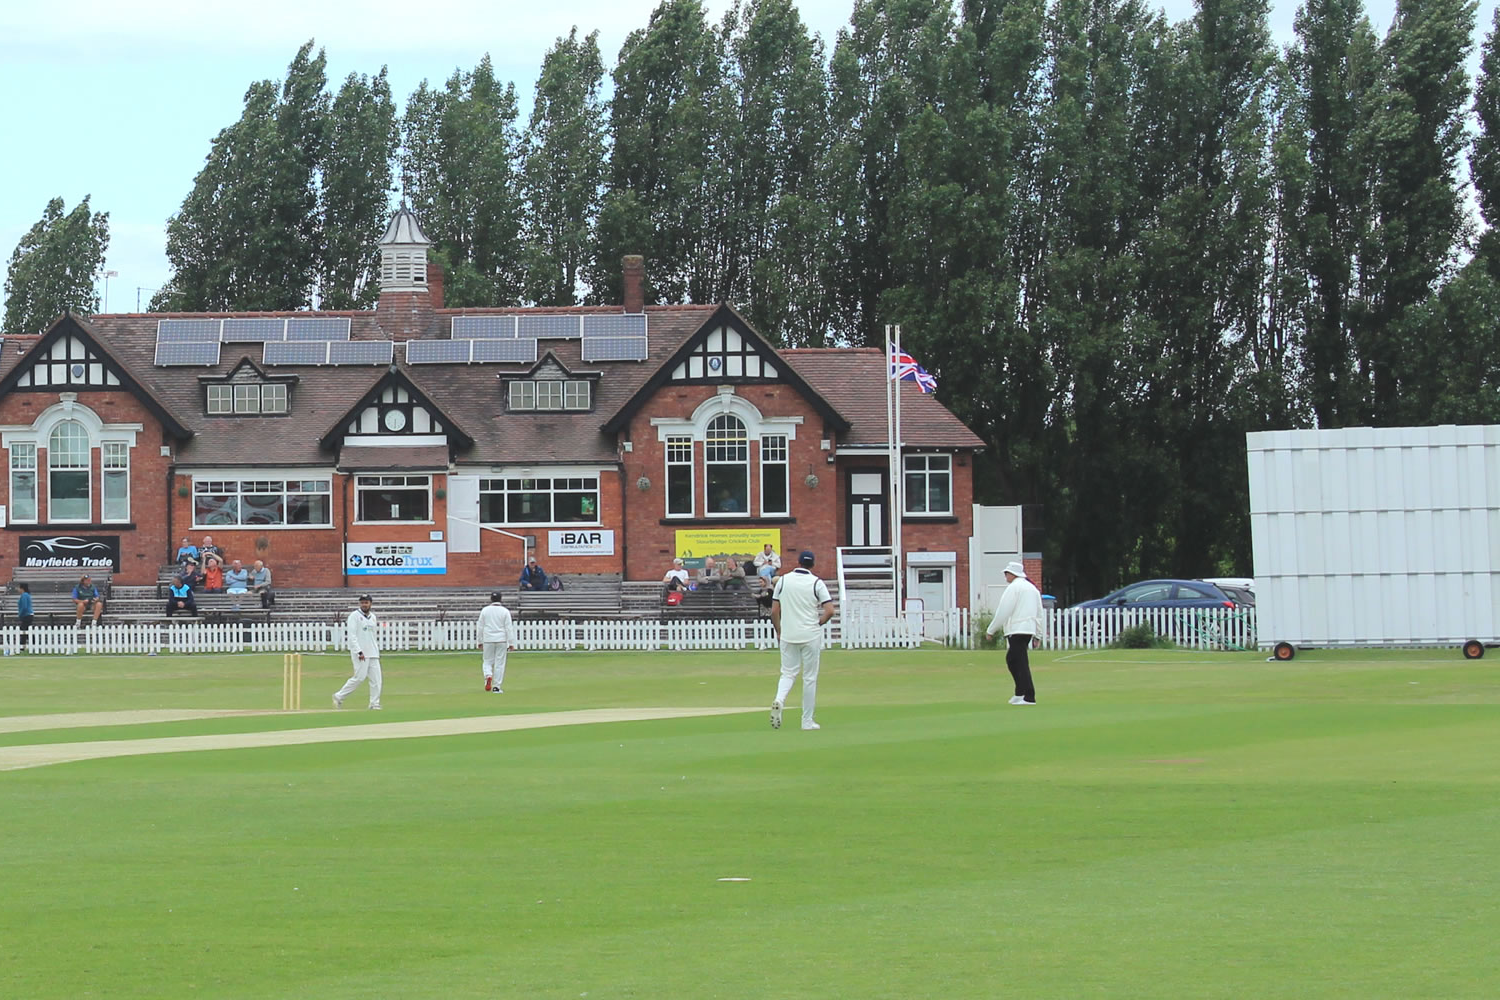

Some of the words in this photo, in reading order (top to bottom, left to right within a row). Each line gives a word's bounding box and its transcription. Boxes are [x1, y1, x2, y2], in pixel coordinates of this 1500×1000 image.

[25, 557, 79, 568] Mayfields
[81, 557, 113, 567] Trade
[364, 555, 432, 566] TradeTrux
